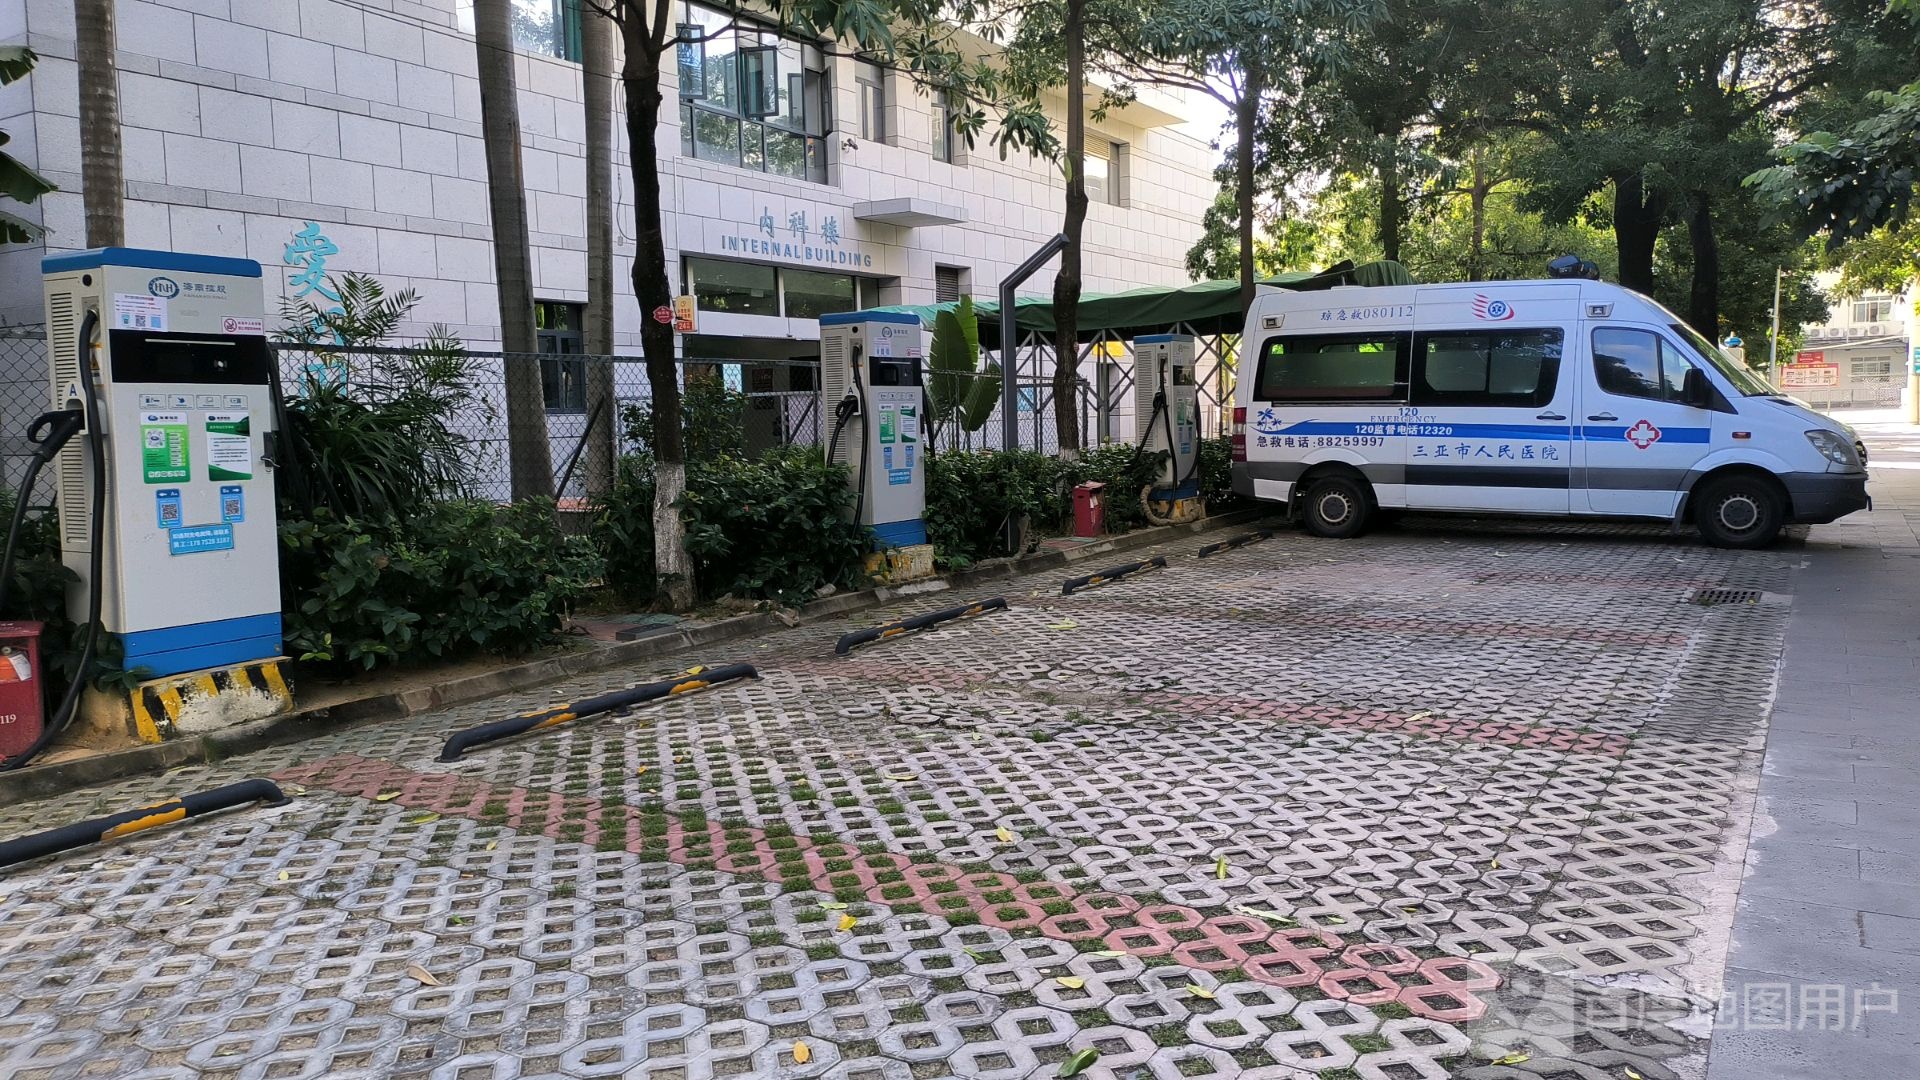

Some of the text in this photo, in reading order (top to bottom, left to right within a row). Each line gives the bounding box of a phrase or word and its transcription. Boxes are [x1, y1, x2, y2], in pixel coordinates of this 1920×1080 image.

[759, 205, 840, 245] 内科楼
[721, 235, 872, 267] INTERNAL BUILDING
[1370, 415, 1437, 423] EMERGENCY
[1398, 407, 1418, 417] 120
[1355, 425, 1453, 435] 120监督电话12320
[1412, 442, 1560, 461] 三亚市人民医院
